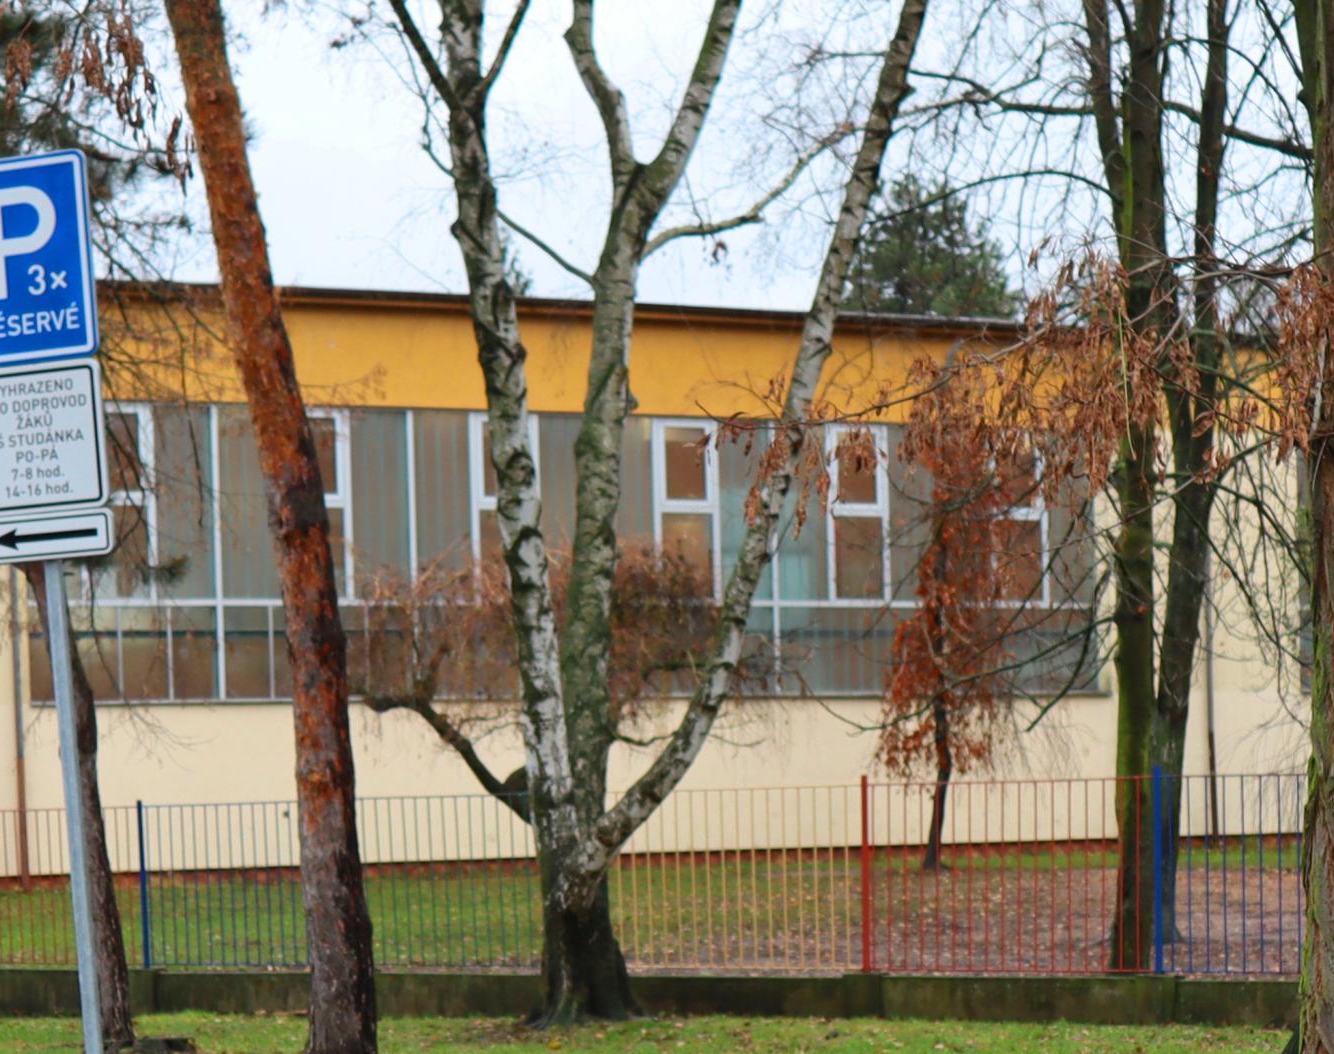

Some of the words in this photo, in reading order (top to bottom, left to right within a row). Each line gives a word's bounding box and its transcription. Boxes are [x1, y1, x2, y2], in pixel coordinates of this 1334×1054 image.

[12, 394, 87, 413] DOPROVOD
[16, 411, 53, 430] ŽÁKŮ
[8, 428, 85, 448] STUDÁNKA
[15, 444, 59, 464] PO-PÁ
[10, 467, 33, 482] 7-8
[36, 465, 65, 479] hod.
[5, 484, 42, 499] 14-16
[45, 481, 74, 496] hod.
